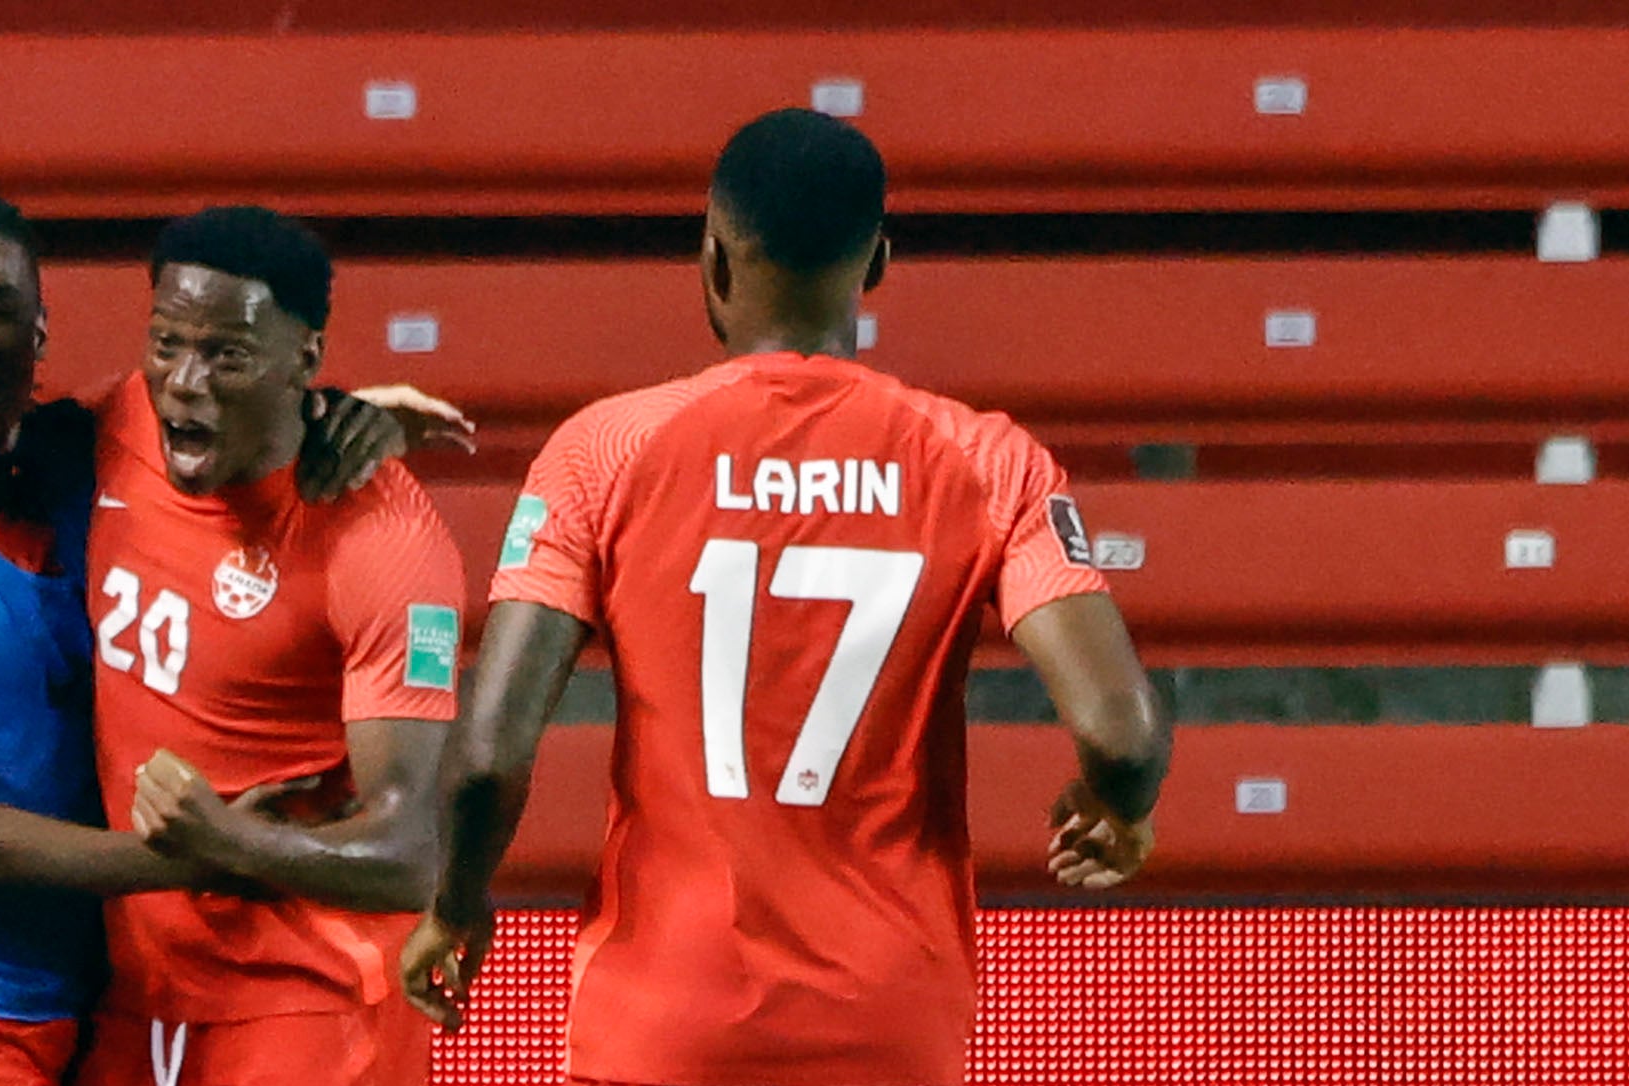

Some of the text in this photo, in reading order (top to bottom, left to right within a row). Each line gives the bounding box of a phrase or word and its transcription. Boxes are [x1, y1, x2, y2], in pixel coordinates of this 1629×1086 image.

[716, 453, 900, 516] LARIN
[98, 566, 190, 695] 20
[689, 538, 925, 806] 17
